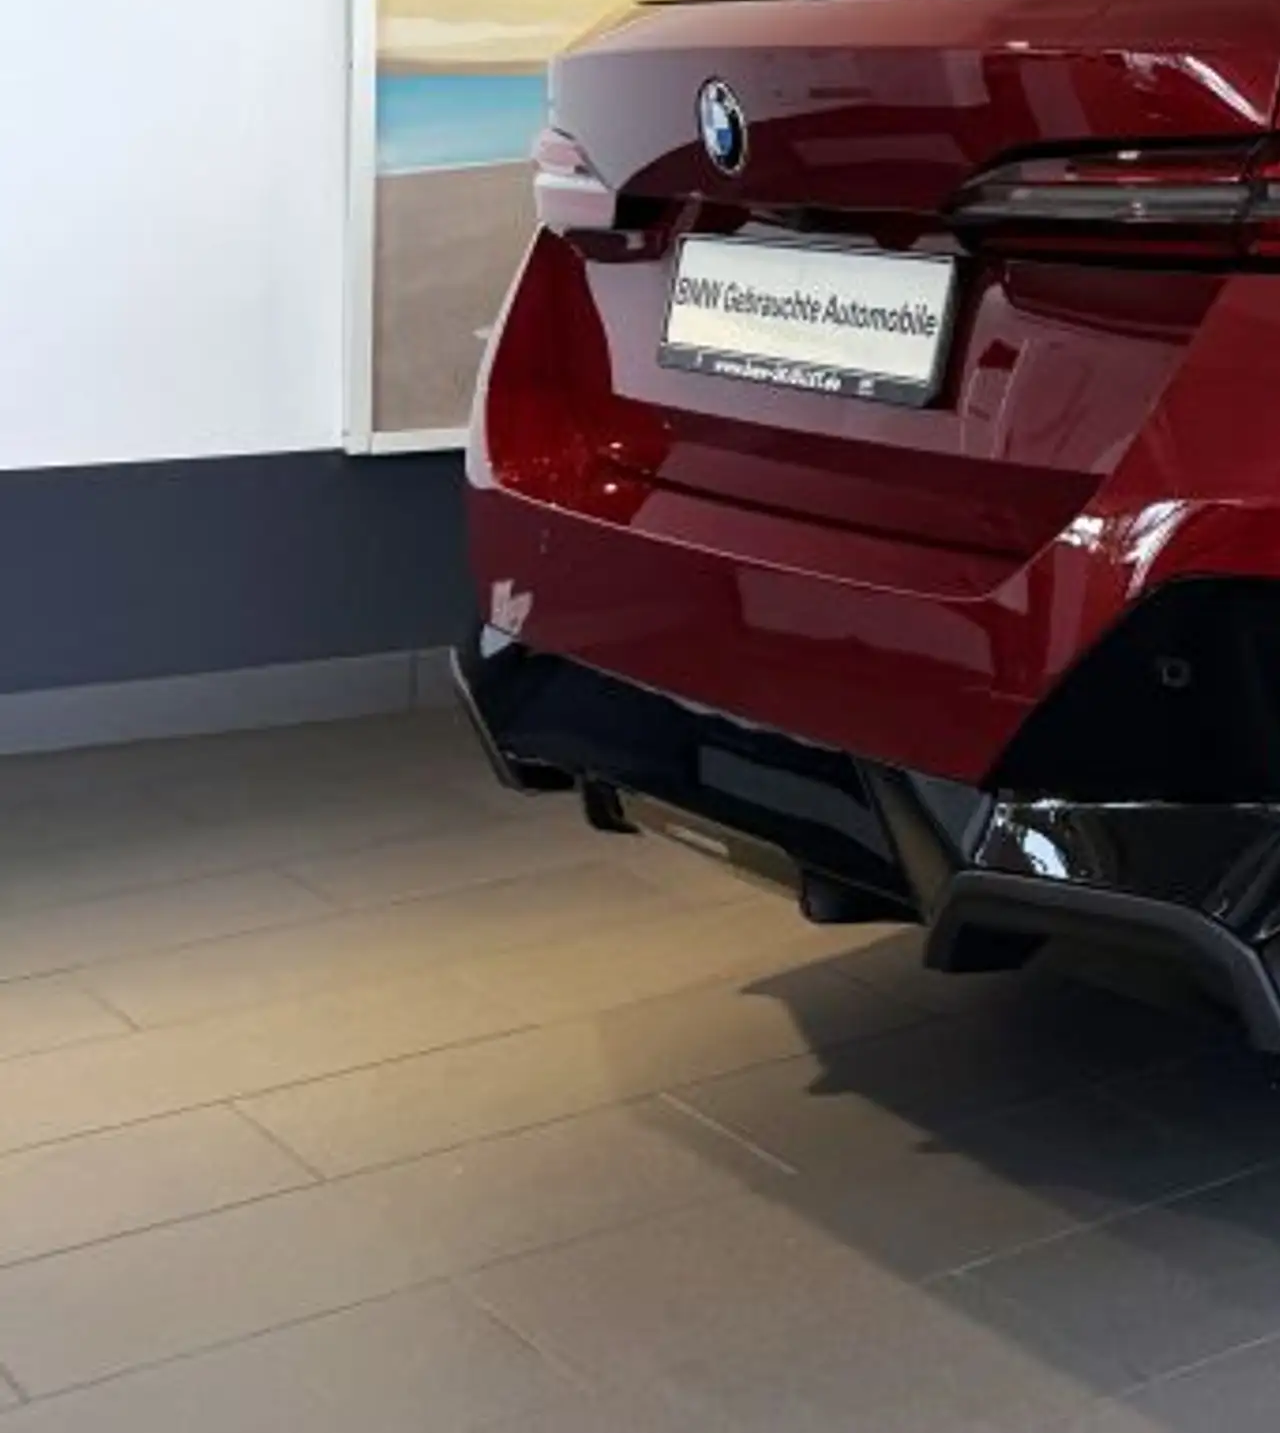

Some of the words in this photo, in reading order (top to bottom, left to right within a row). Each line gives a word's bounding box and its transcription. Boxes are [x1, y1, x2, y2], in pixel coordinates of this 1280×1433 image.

[674, 277, 723, 308] BMW
[723, 282, 822, 325] Gebrauchte
[823, 294, 937, 337] Automobile
